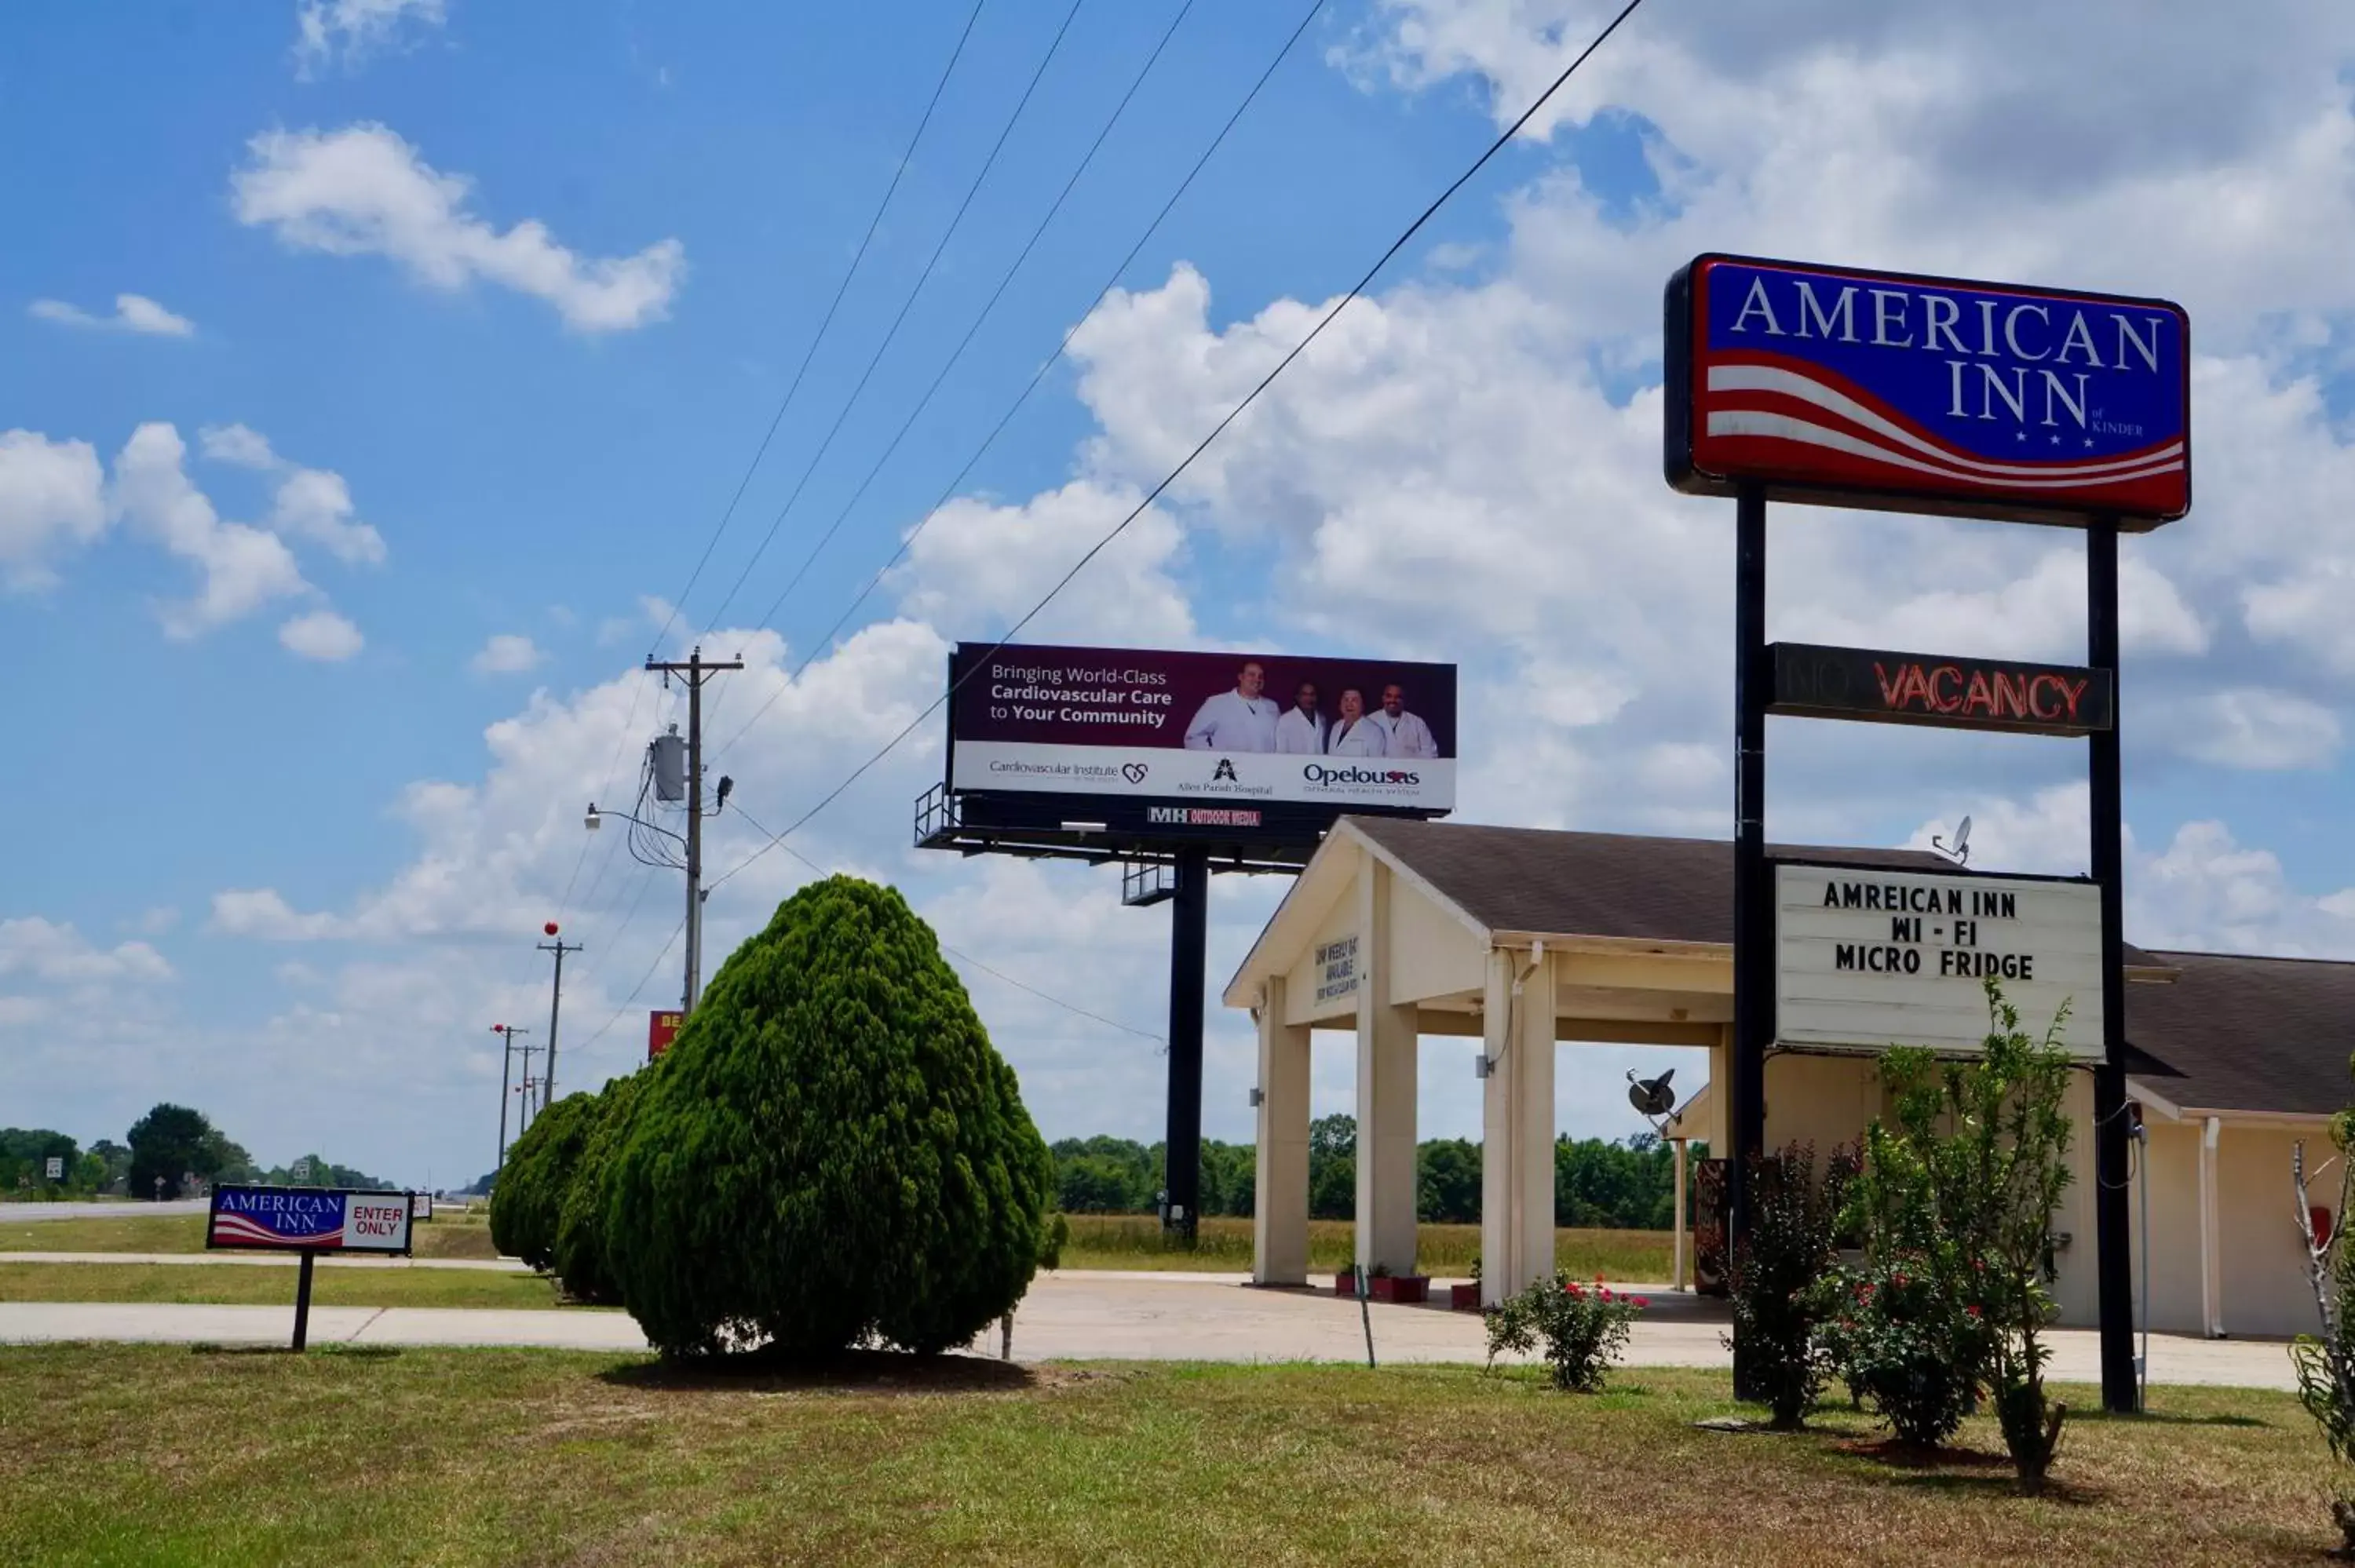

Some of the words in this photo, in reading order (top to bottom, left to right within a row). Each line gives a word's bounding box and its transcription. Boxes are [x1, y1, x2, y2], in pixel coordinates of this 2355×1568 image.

[1729, 275, 2163, 374] AMERICAN
[1944, 360, 2091, 430] INN
[2091, 407, 2105, 419] of
[2091, 420, 2144, 437] KINDER
[991, 665, 1062, 684] Bringing
[1067, 668, 1167, 685] World-Class
[991, 684, 1126, 704] Cardiovascular
[1131, 690, 1173, 706] Care
[1872, 661, 2089, 720] VACANCY
[991, 706, 1008, 719] to
[1013, 706, 1056, 721] Your
[1060, 708, 1167, 729] Community
[989, 760, 1071, 775] Cardiovascular
[1073, 764, 1119, 776] Institute
[1148, 806, 1188, 823] MH
[1190, 808, 1230, 825] OUTDOOR
[1824, 881, 1962, 914] AMREICAN
[1973, 891, 2016, 918] INN
[1835, 943, 1921, 974] MICRO
[1940, 950, 2033, 981] FRIDGE
[221, 1194, 342, 1213] AMERICAN
[276, 1212, 318, 1229] INN
[353, 1205, 403, 1222] ENTER
[356, 1221, 398, 1236] ONLY
